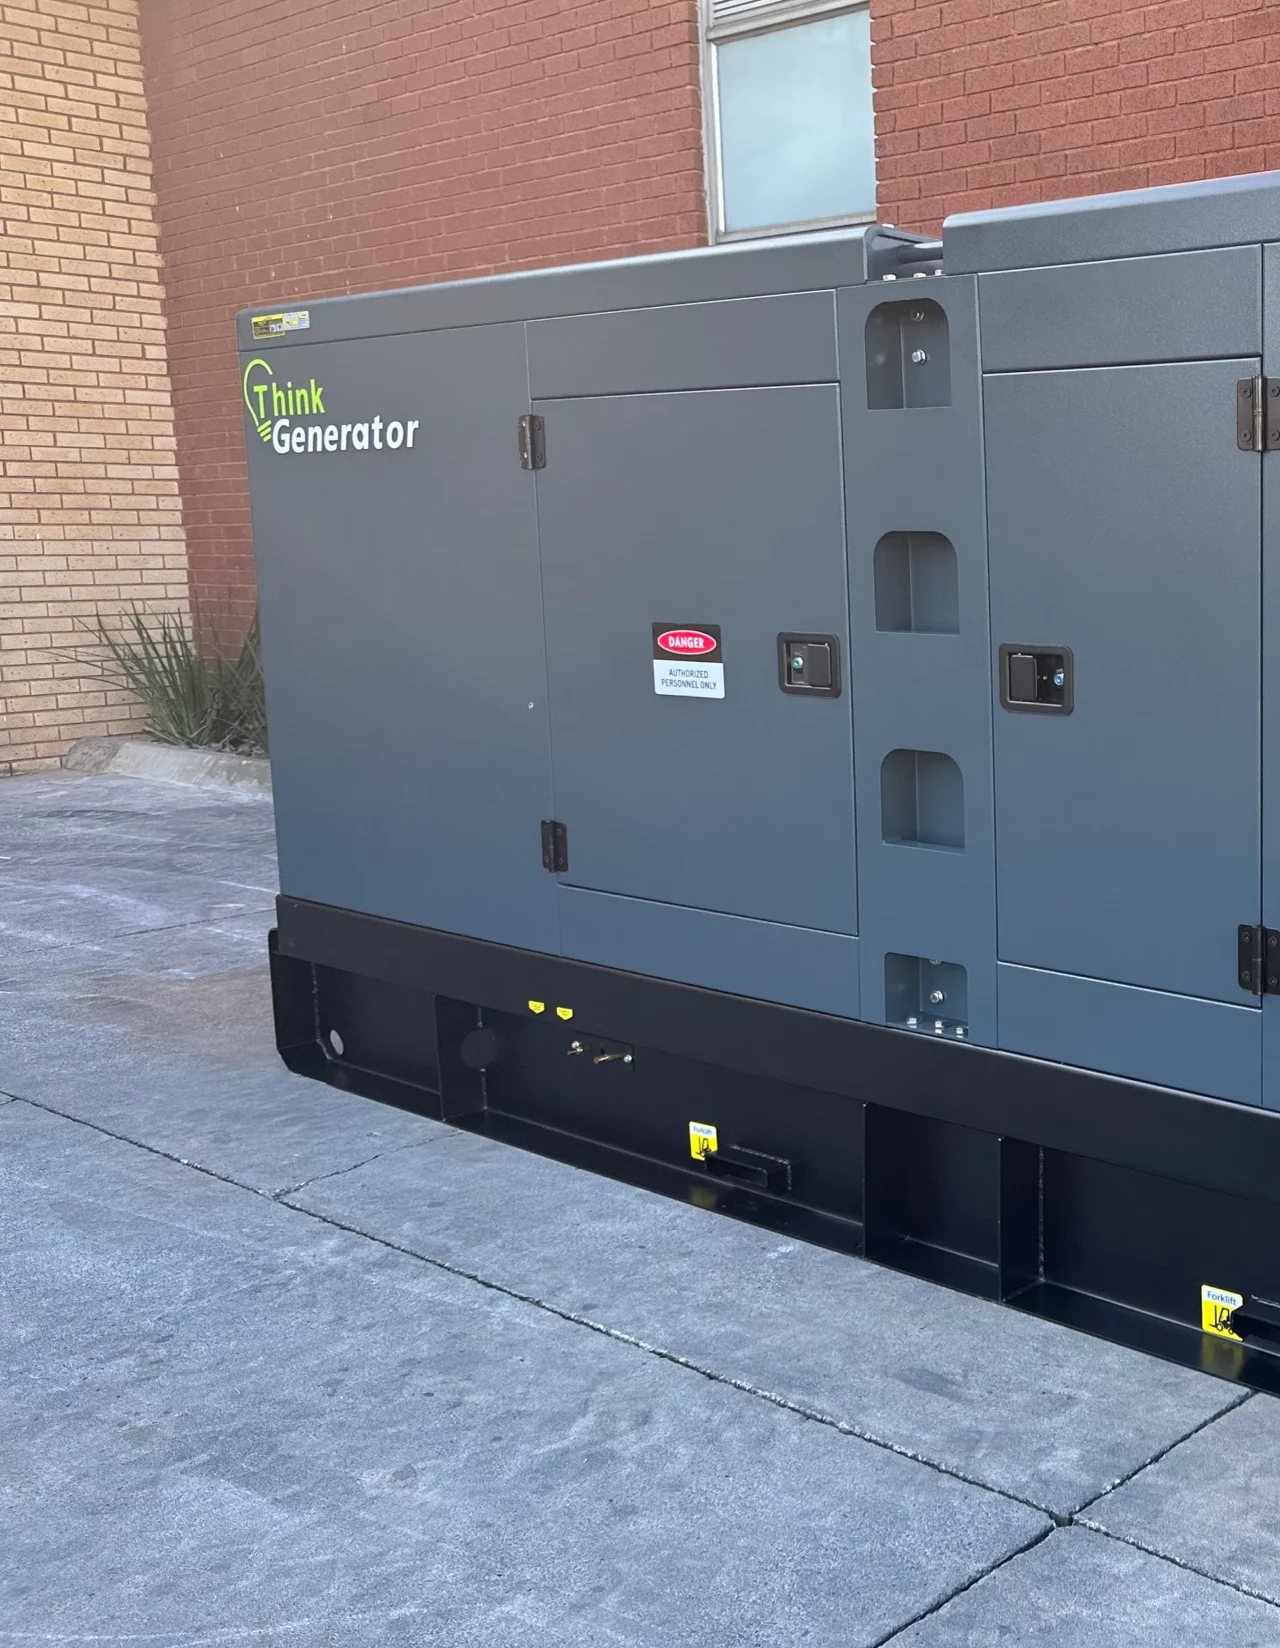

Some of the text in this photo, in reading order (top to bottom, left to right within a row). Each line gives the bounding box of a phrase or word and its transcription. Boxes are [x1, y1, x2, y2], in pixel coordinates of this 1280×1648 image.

[253, 379, 325, 419] Think
[272, 415, 419, 454] Generator
[668, 636, 705, 649] DANGER
[668, 668, 709, 679] AUTHORIZED
[661, 678, 717, 690] PERSONNEL ONLY
[1206, 1290, 1237, 1306] Forklift
